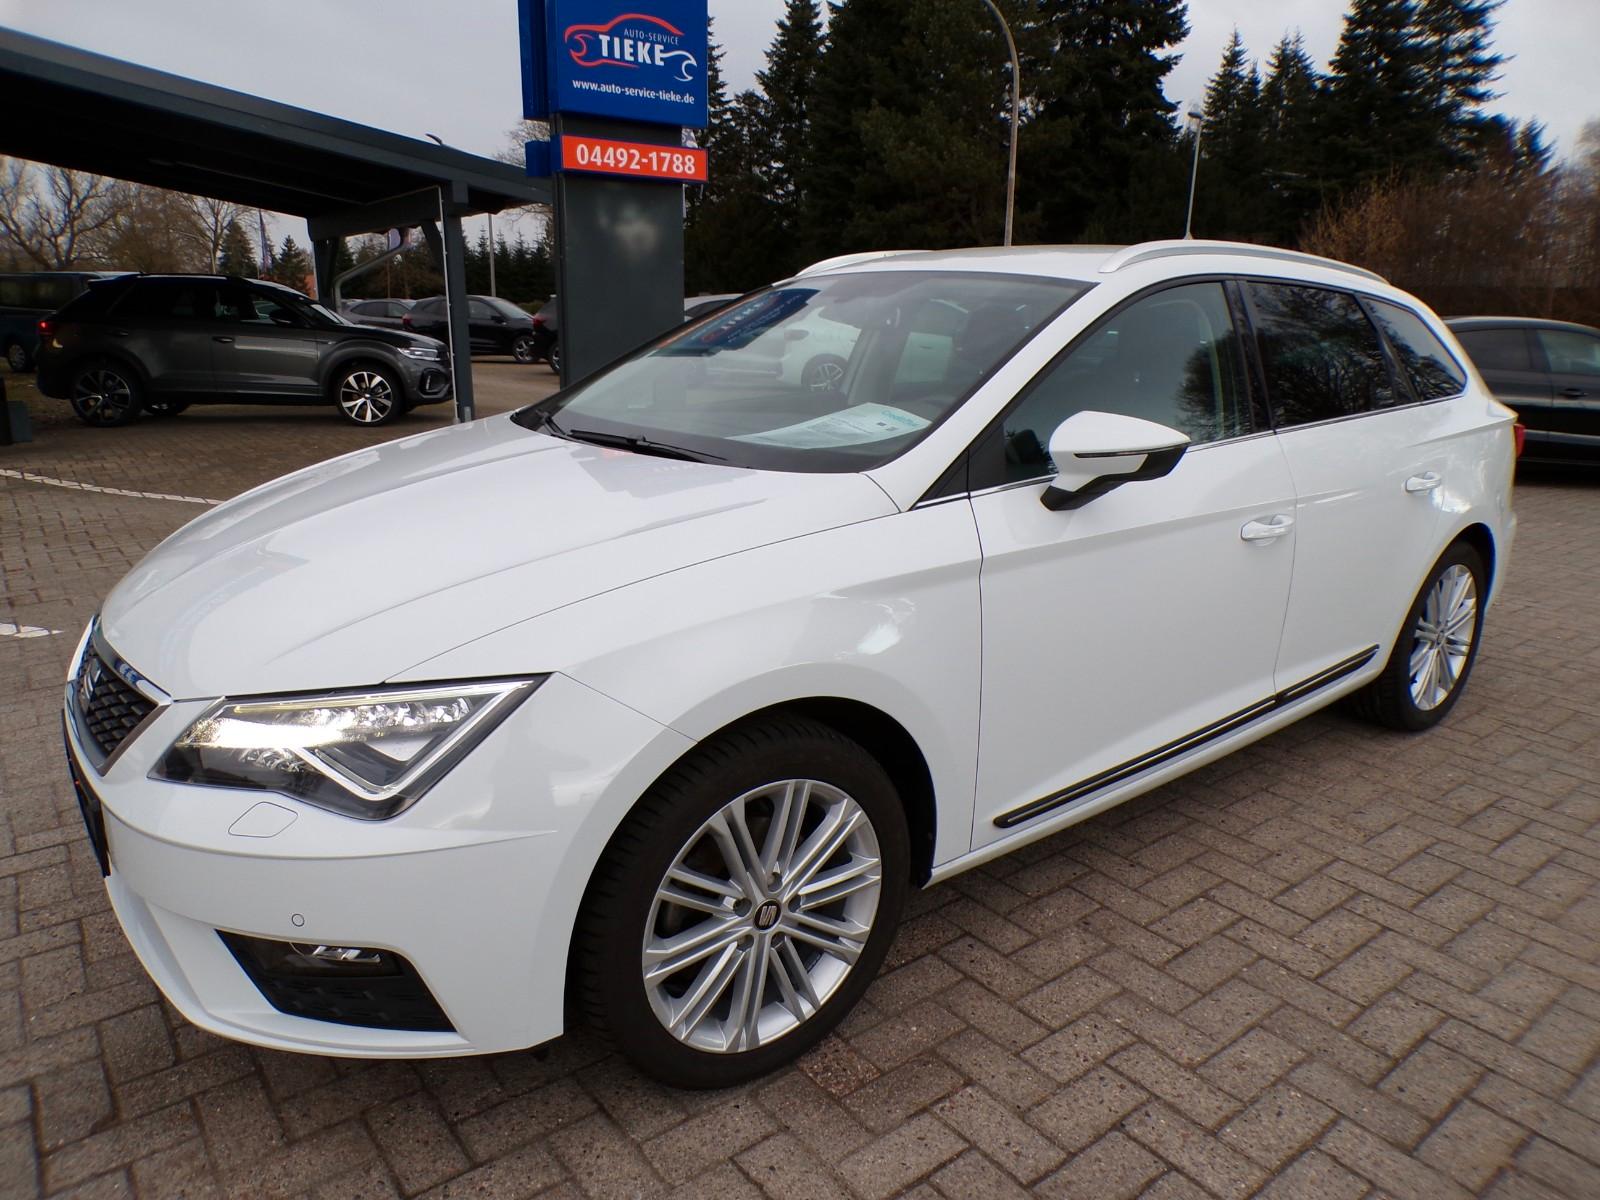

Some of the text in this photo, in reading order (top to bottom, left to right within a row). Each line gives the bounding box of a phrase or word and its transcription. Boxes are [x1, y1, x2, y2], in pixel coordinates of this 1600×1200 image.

[598, 34, 665, 67] TIEKE
[624, 28, 679, 45] AUTO-SERVICE
[572, 79, 695, 105] www.auto-service-tieke.de
[576, 143, 696, 174] 04492-1788
